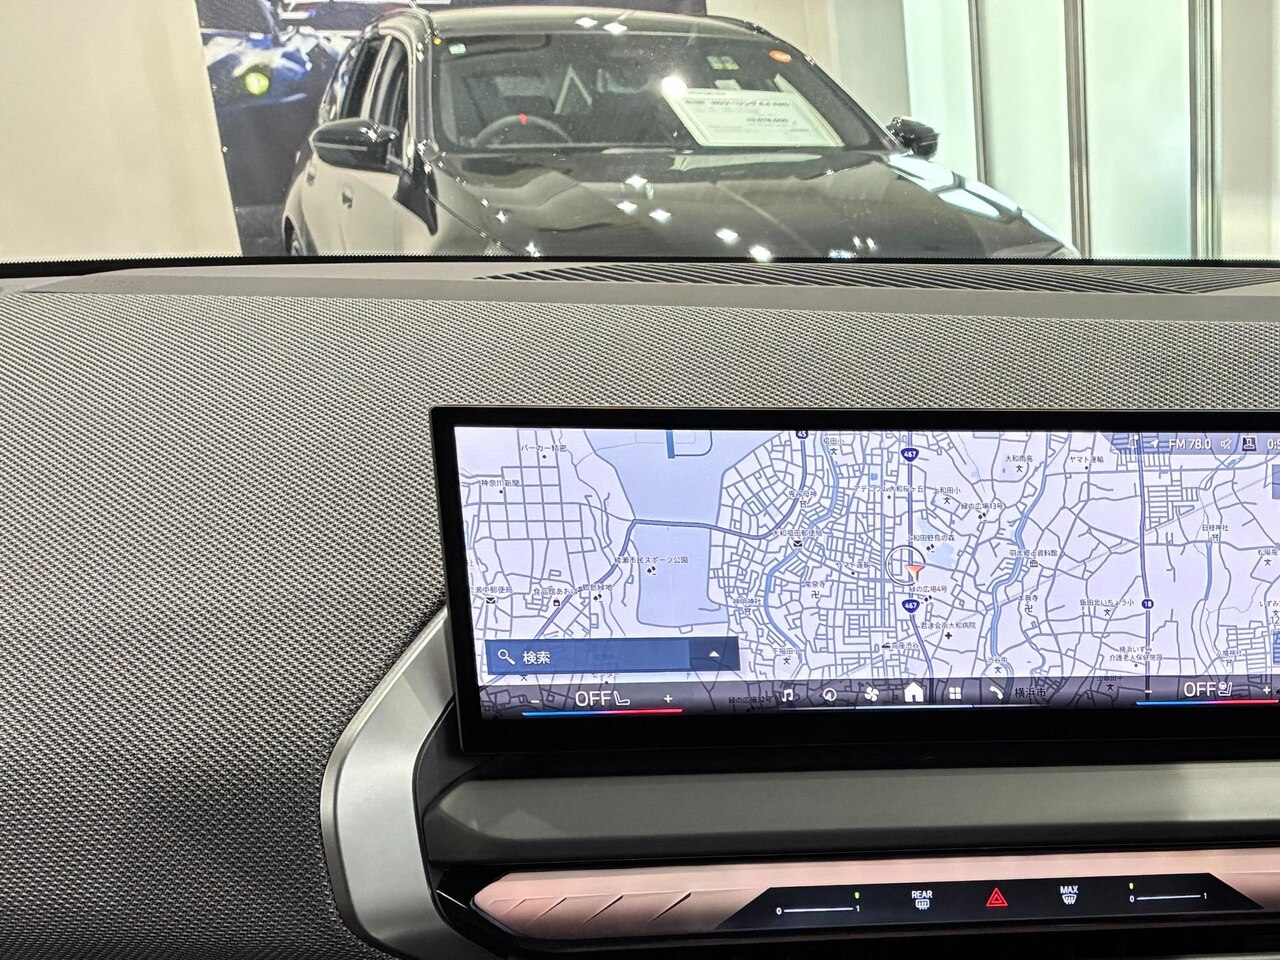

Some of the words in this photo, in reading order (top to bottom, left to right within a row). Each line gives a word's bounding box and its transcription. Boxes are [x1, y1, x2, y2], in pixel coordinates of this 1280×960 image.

[1169, 439, 1185, 449] FM
[1188, 439, 1212, 449] 78.0
[903, 449, 917, 459] 467
[903, 601, 918, 610] 467
[522, 651, 551, 664] 検索
[1014, 687, 1047, 699] 横浜市
[1183, 682, 1217, 697] OFF
[575, 691, 612, 707] OFF
[911, 889, 933, 899] REAR
[1060, 885, 1078, 894] MAX
